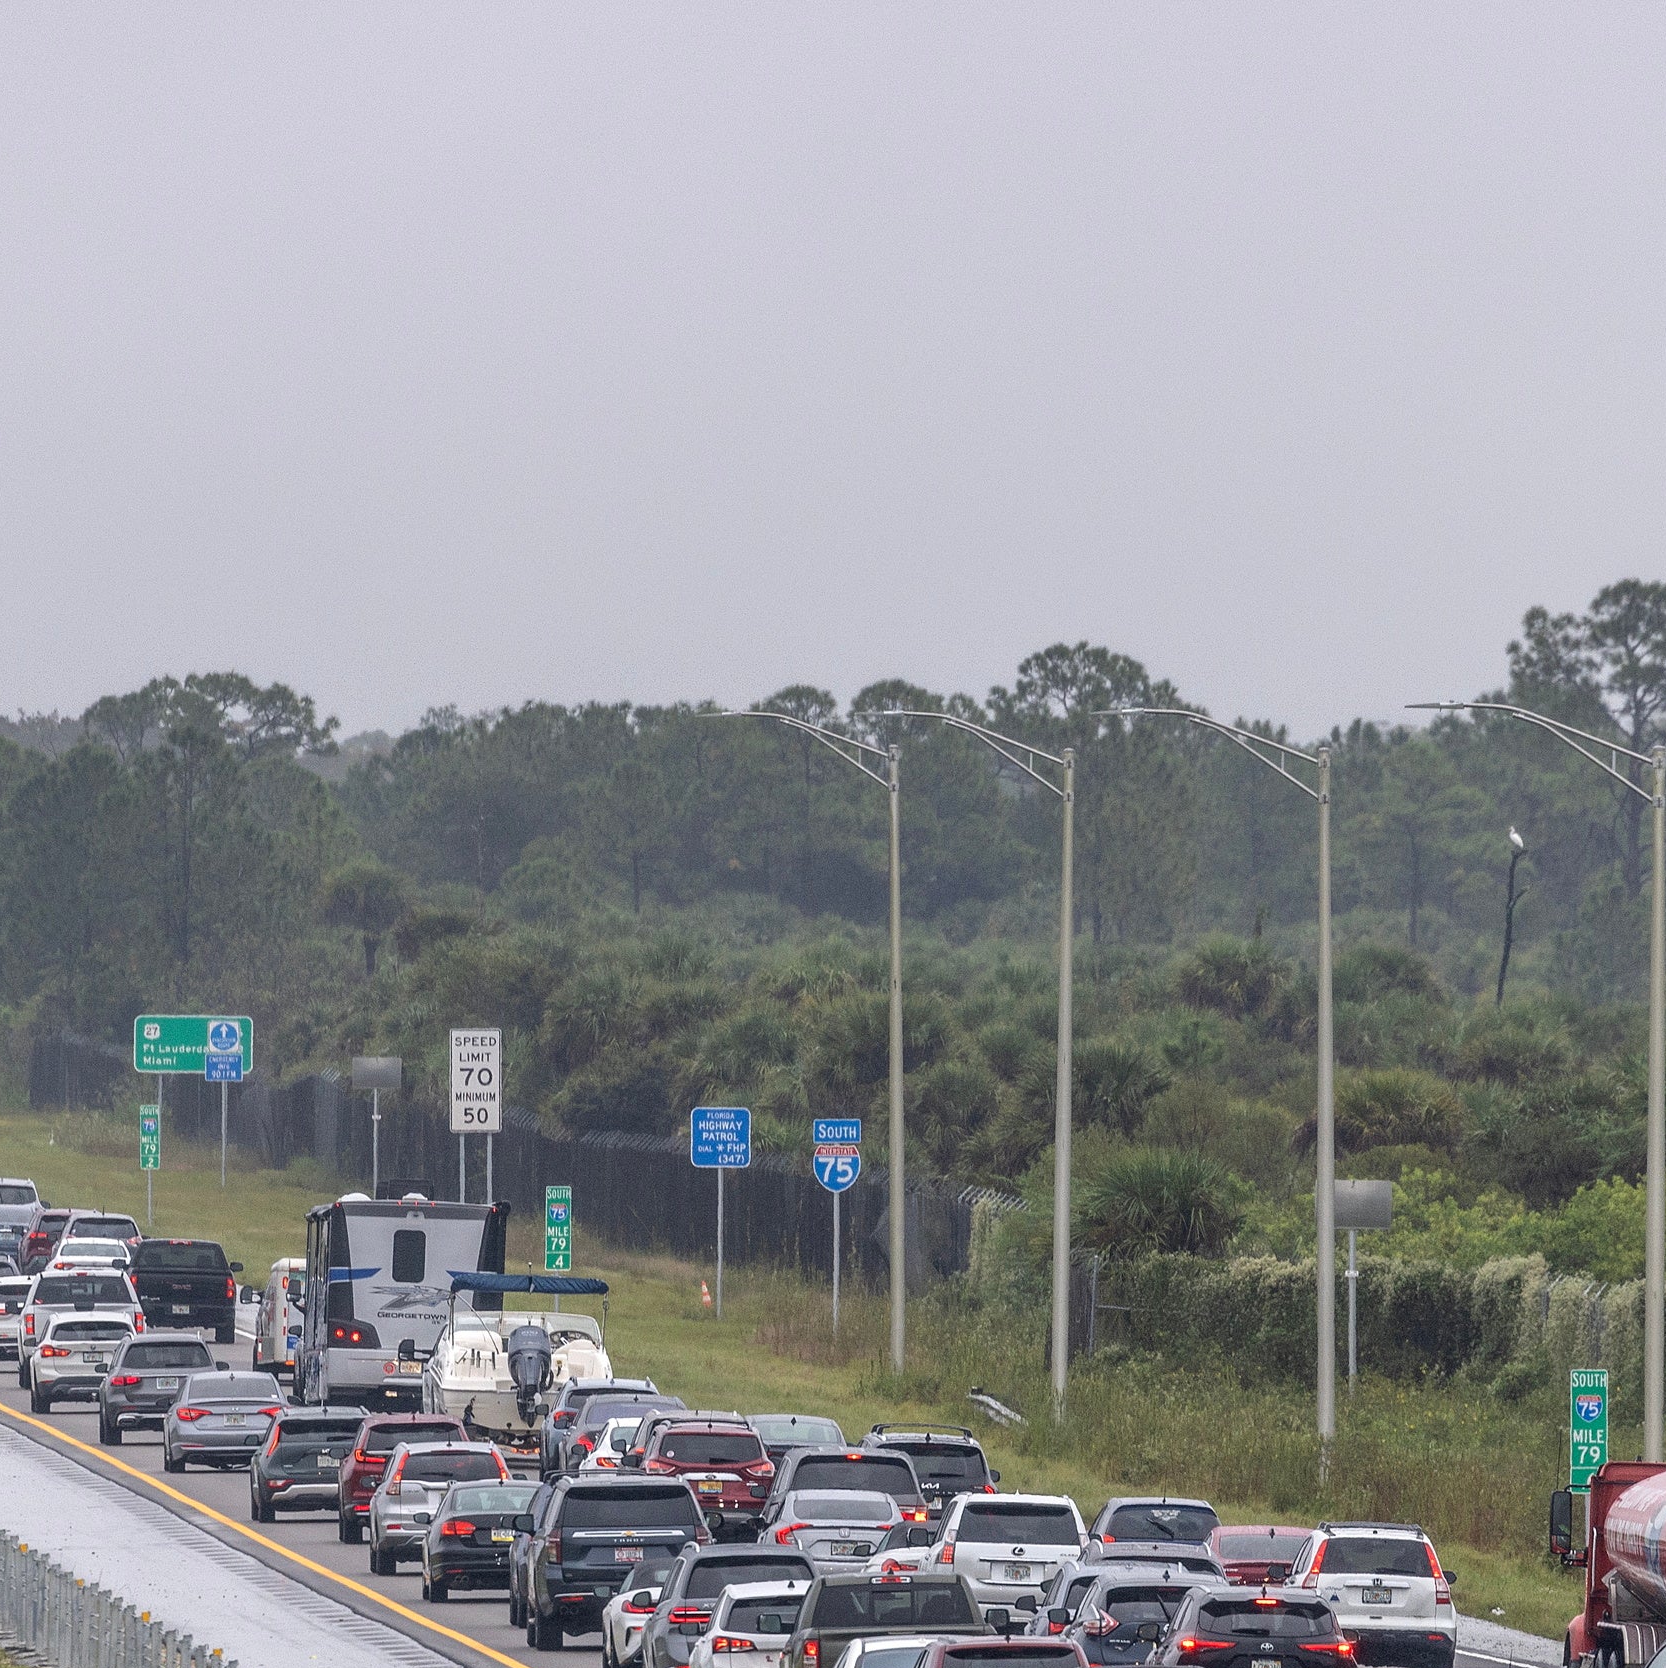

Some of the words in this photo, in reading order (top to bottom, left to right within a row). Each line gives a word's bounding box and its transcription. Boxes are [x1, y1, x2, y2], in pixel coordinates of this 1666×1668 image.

[146, 1026, 158, 1036] 27
[455, 1037, 497, 1047] SPEED
[143, 1044, 155, 1053] Ft
[143, 1056, 177, 1065] Miami
[459, 1052, 491, 1062] LIMIT
[459, 1068, 493, 1086] 70
[455, 1092, 496, 1102] MINIMUM
[464, 1107, 488, 1124] 50
[706, 1112, 735, 1120] FLORIDA
[698, 1121, 743, 1130] HIGHWAY
[818, 1124, 857, 1139] SOUTH
[141, 1135, 158, 1144] MILE
[702, 1132, 739, 1142] PATROL
[144, 1144, 156, 1154] 79
[718, 1155, 745, 1164] (347)
[818, 1158, 853, 1183] 75
[547, 1188, 571, 1200] SOUTH
[551, 1208, 565, 1219] 75
[547, 1226, 569, 1237] MILE
[551, 1238, 566, 1250] 79
[552, 1254, 564, 1268] .4
[377, 1311, 447, 1320] GEORGETOWN
[1572, 1372, 1607, 1388] SOUTH
[1578, 1402, 1599, 1417] 75
[1573, 1429, 1605, 1443] MILE
[1577, 1446, 1601, 1464] 79
